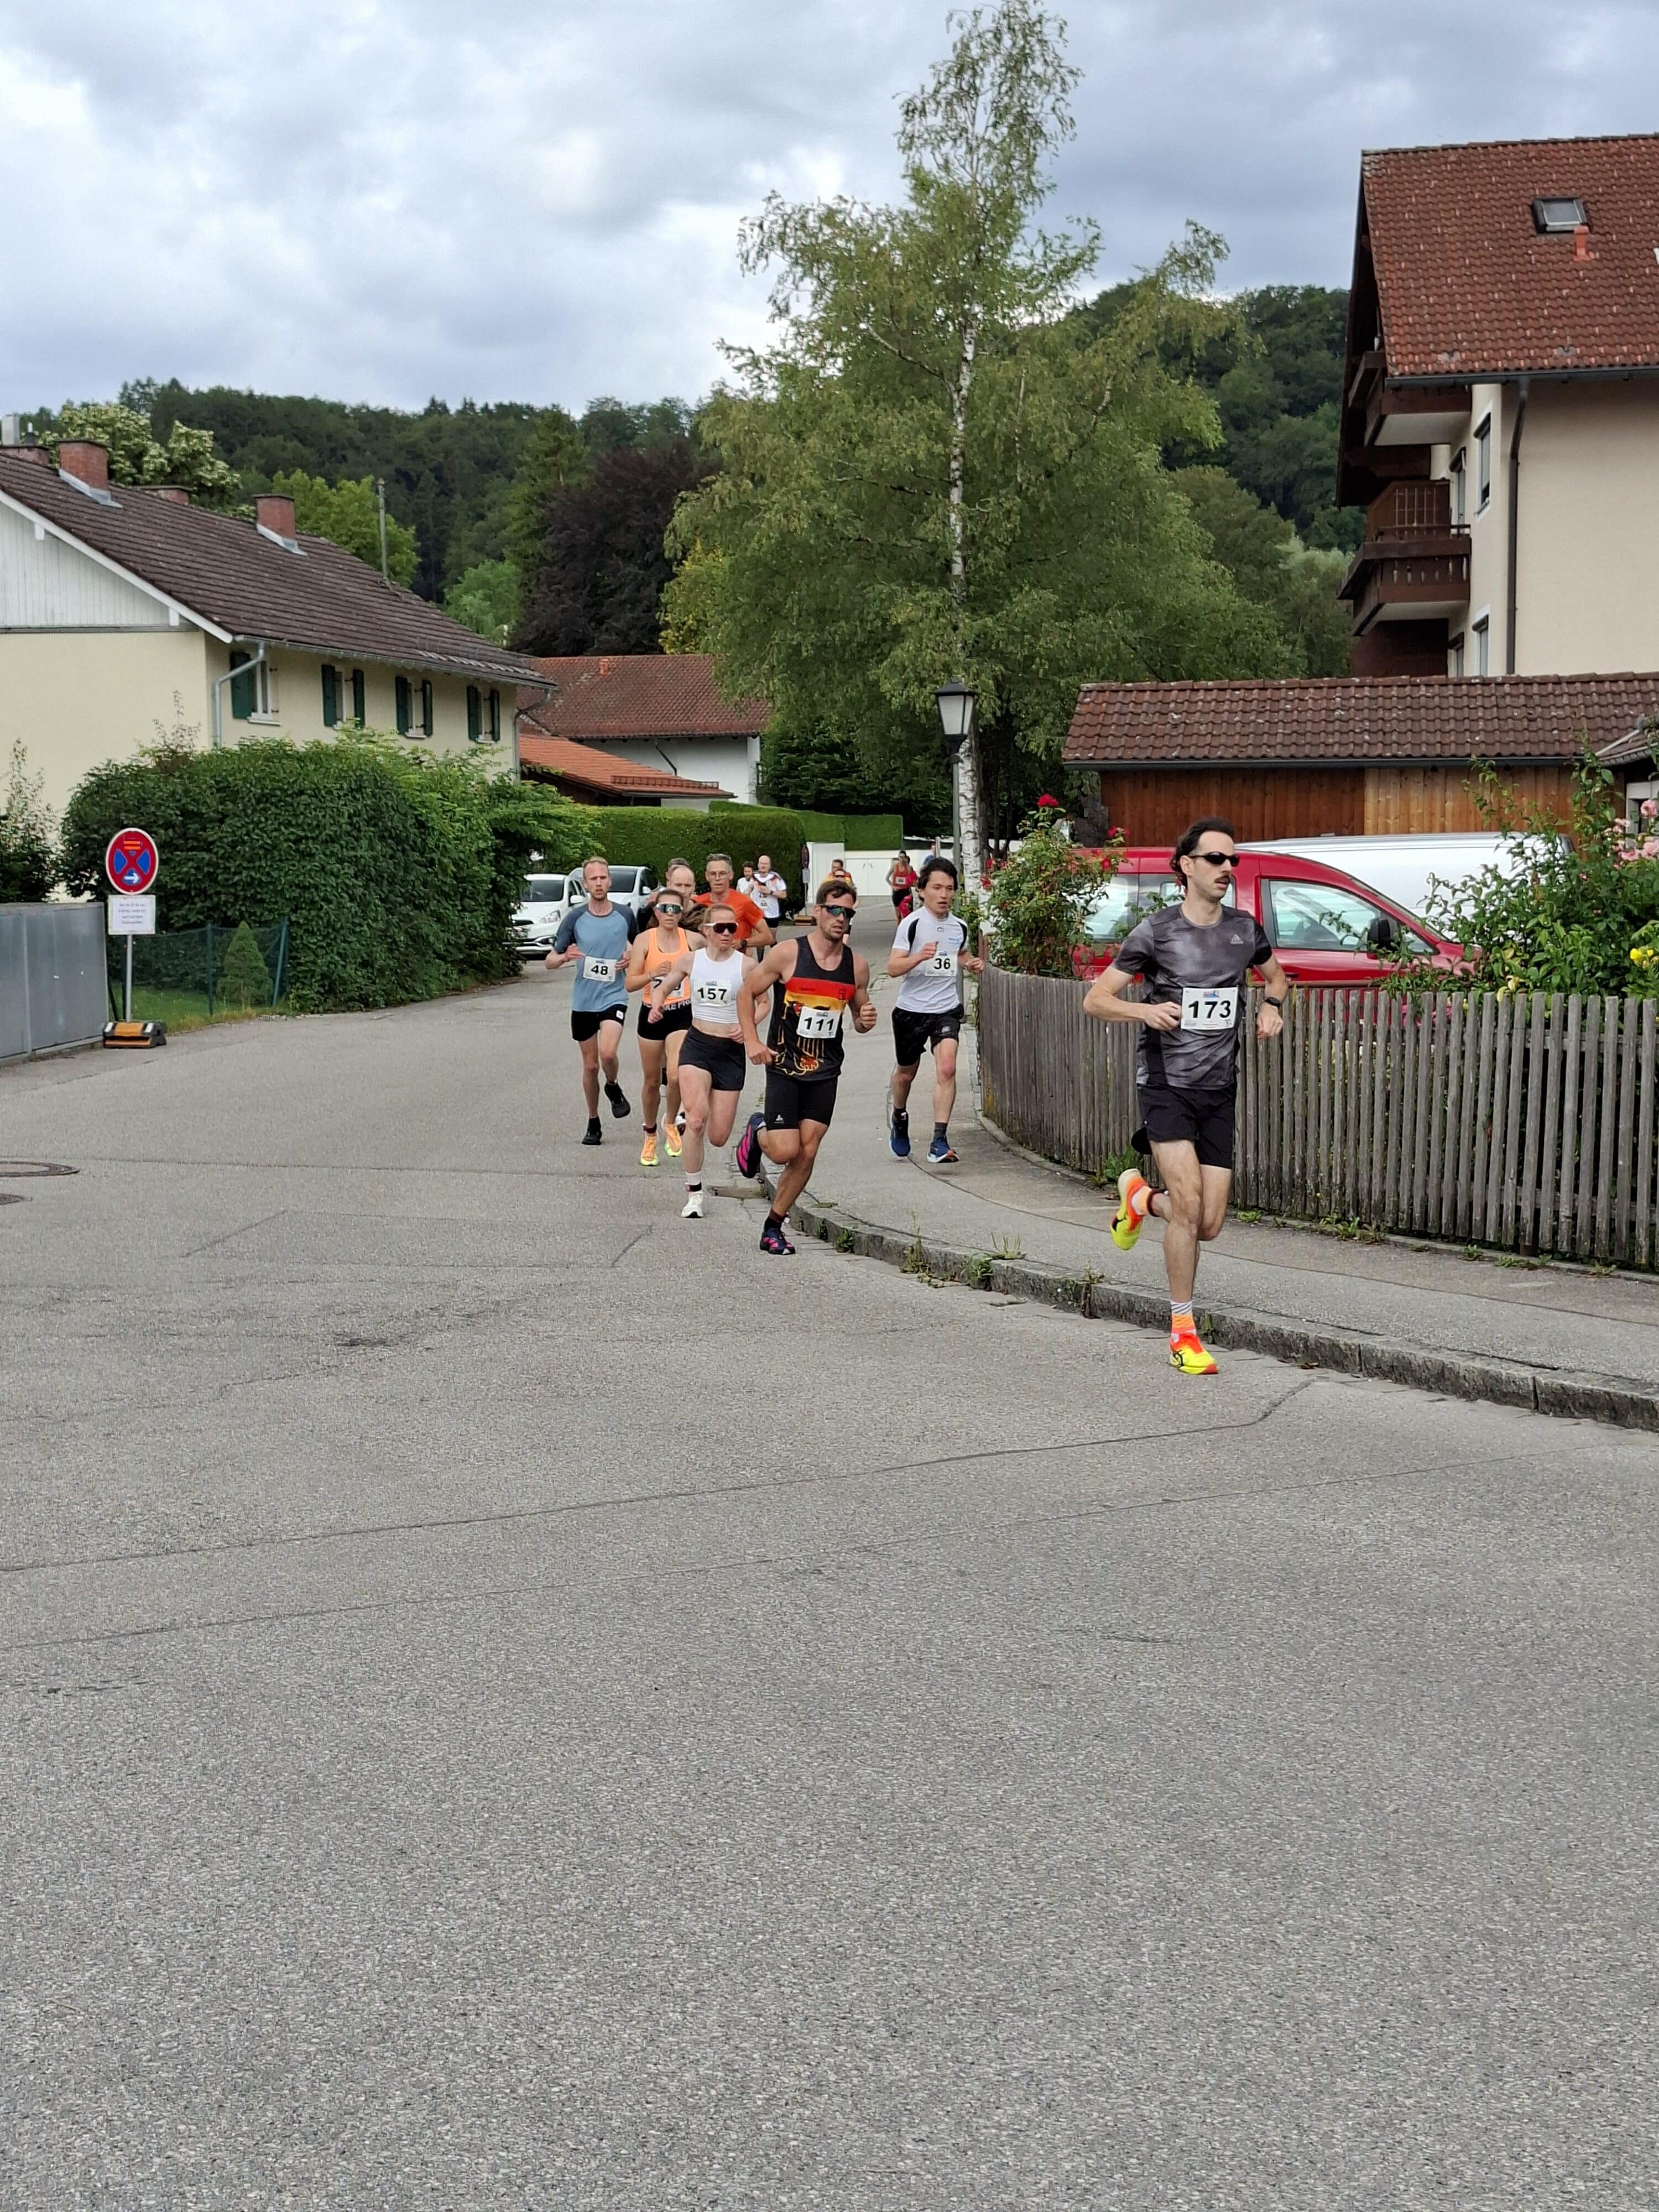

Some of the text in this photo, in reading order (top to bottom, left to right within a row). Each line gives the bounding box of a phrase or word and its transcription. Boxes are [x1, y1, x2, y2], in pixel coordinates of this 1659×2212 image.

[933, 958, 951, 969] 36
[591, 965, 608, 975] 48
[697, 988, 727, 1000] 157
[1188, 1000, 1231, 1019] 173
[804, 1017, 834, 1031] 111
